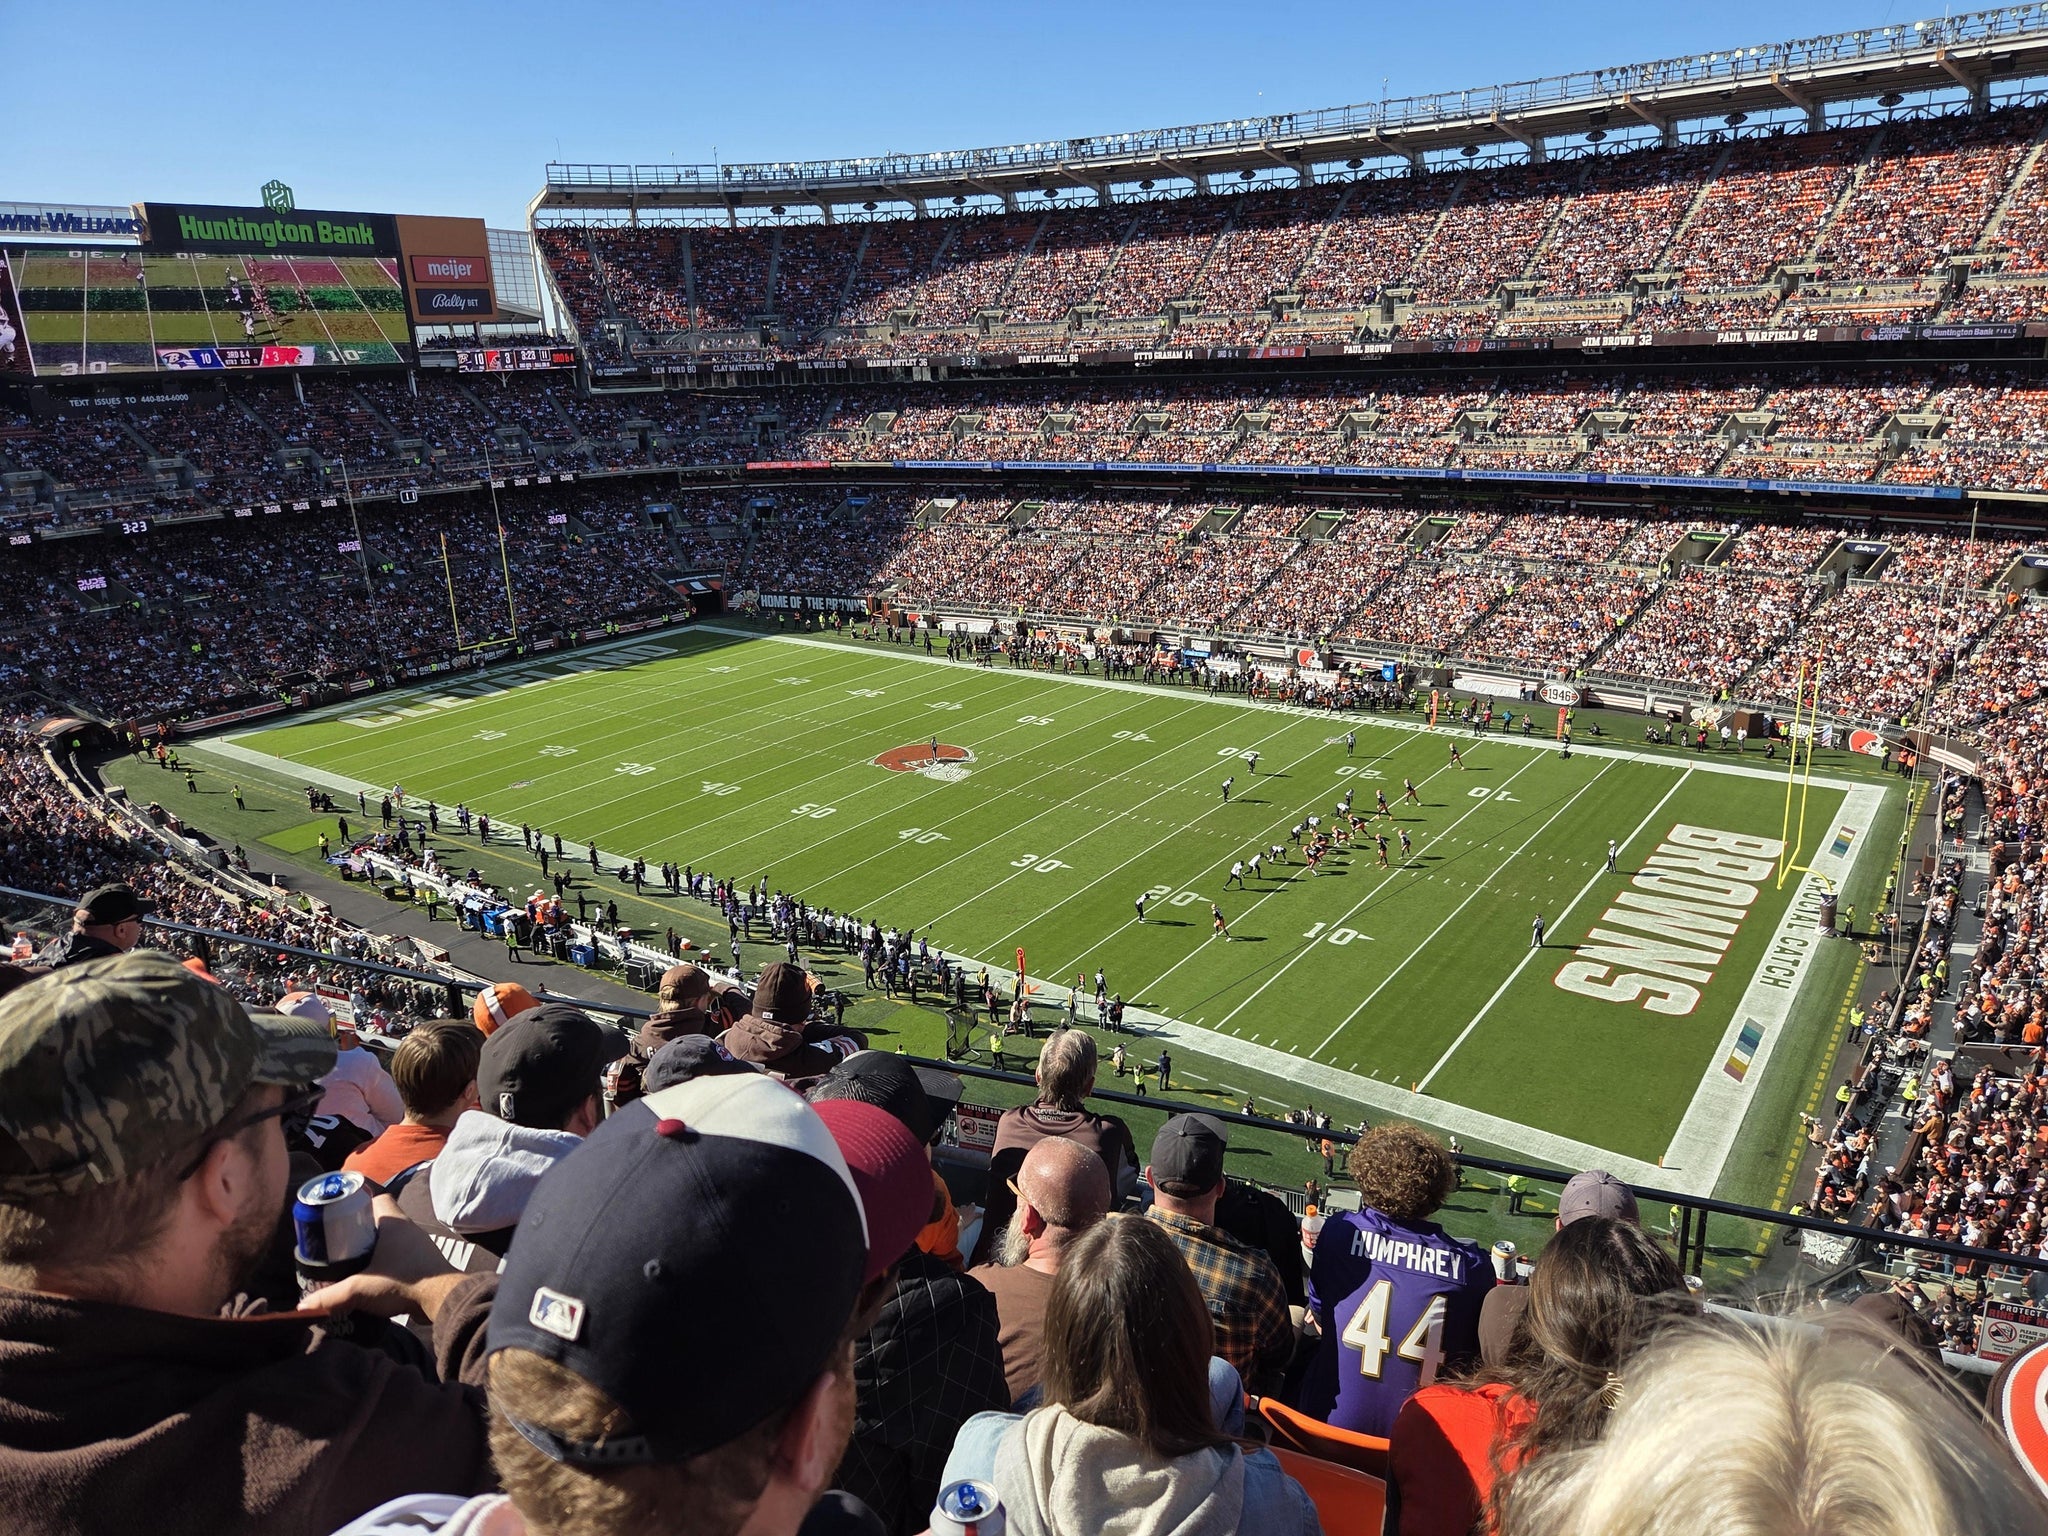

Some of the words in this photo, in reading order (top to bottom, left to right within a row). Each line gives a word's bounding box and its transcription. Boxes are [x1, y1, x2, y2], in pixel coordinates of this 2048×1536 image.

[179, 215, 313, 247] Huntington
[316, 220, 375, 245] Bank
[428, 259, 472, 277] meijer
[432, 293, 467, 310] Bally
[467, 299, 479, 307] BET
[1717, 330, 1743, 343] PAUL
[1745, 329, 1799, 342] WARFIELD
[1802, 329, 1818, 341] 42
[1879, 326, 1911, 334] CRUCIAL
[1932, 327, 1972, 338] Huntington
[1973, 328, 1994, 336] Bank
[1582, 337, 1601, 347] JIM
[1602, 336, 1636, 346] BROWN
[1639, 335, 1652, 346] 32
[1878, 333, 1903, 341] CATCH
[227, 351, 239, 359] 3RD
[521, 350, 536, 360] 3:23
[1134, 352, 1153, 360] OTTO
[1154, 351, 1183, 359] GRAHAM
[1185, 350, 1193, 359] 14
[1343, 345, 1363, 354] PAUL
[1364, 344, 1392, 353] BROWN
[200, 353, 212, 364] 10
[273, 351, 280, 362] 3
[475, 353, 484, 365] 10
[505, 352, 511, 363] 3
[1018, 355, 1043, 363] DANTE
[1044, 355, 1068, 363] LAVELLI
[60, 361, 107, 376] 30
[713, 364, 729, 372] CLAY
[729, 364, 765, 372] MATTHEWS
[766, 363, 775, 372] 57
[798, 362, 813, 370] BILL
[814, 361, 836, 369] WILLIS
[837, 361, 847, 369] 60
[867, 359, 890, 368] MARION
[891, 359, 917, 367] MOTLEY
[918, 358, 928, 367] 36
[668, 366, 686, 374] FORD
[687, 365, 697, 374] 80
[69, 399, 89, 407] TEXT
[94, 397, 121, 406] ISSUES
[125, 396, 137, 404] TO
[141, 394, 189, 403] 440-824-6000
[1467, 471, 1507, 479] CLEVELAND'S
[1612, 476, 1657, 484] CLEVELAND'S
[1776, 482, 1828, 491] CLEVELAND'S
[1891, 487, 1925, 496] REMEDY
[403, 491, 417, 501] 11
[122, 521, 147, 534] 3:23
[77, 577, 105, 587] DUDE
[78, 584, 107, 592] WIPES
[760, 594, 789, 608] HOME
[790, 594, 802, 609] OF
[805, 597, 825, 610] THE
[337, 644, 679, 729] CLEVELAND
[779, 676, 811, 686] 20
[850, 688, 885, 698] 30
[1548, 688, 1572, 702] 1946
[931, 701, 963, 710] 40
[1016, 715, 1055, 726] 50
[476, 729, 507, 741] 10
[1111, 730, 1150, 743] 40
[544, 744, 578, 757] 20
[615, 761, 656, 776] 30
[1334, 765, 1381, 780] 20
[704, 781, 741, 796] 40
[1467, 786, 1512, 802] 10
[791, 803, 837, 819] 50
[898, 827, 943, 844] 40
[1010, 854, 1062, 873] 30
[1147, 884, 1199, 907] 20
[1552, 823, 1788, 1016] BROWNS
[1303, 922, 1358, 946] 10
[1760, 936, 1809, 990] CATCH
[963, 1103, 988, 1113] PROTECT
[1350, 1229, 1462, 1280] HUMPHREY
[2000, 1304, 2042, 1317] PROTECT
[1988, 1310, 2014, 1321] RING
[2018, 1314, 2032, 1324] OF
[1343, 1280, 1448, 1386] 44
[2019, 1328, 2038, 1337] PLEASE
